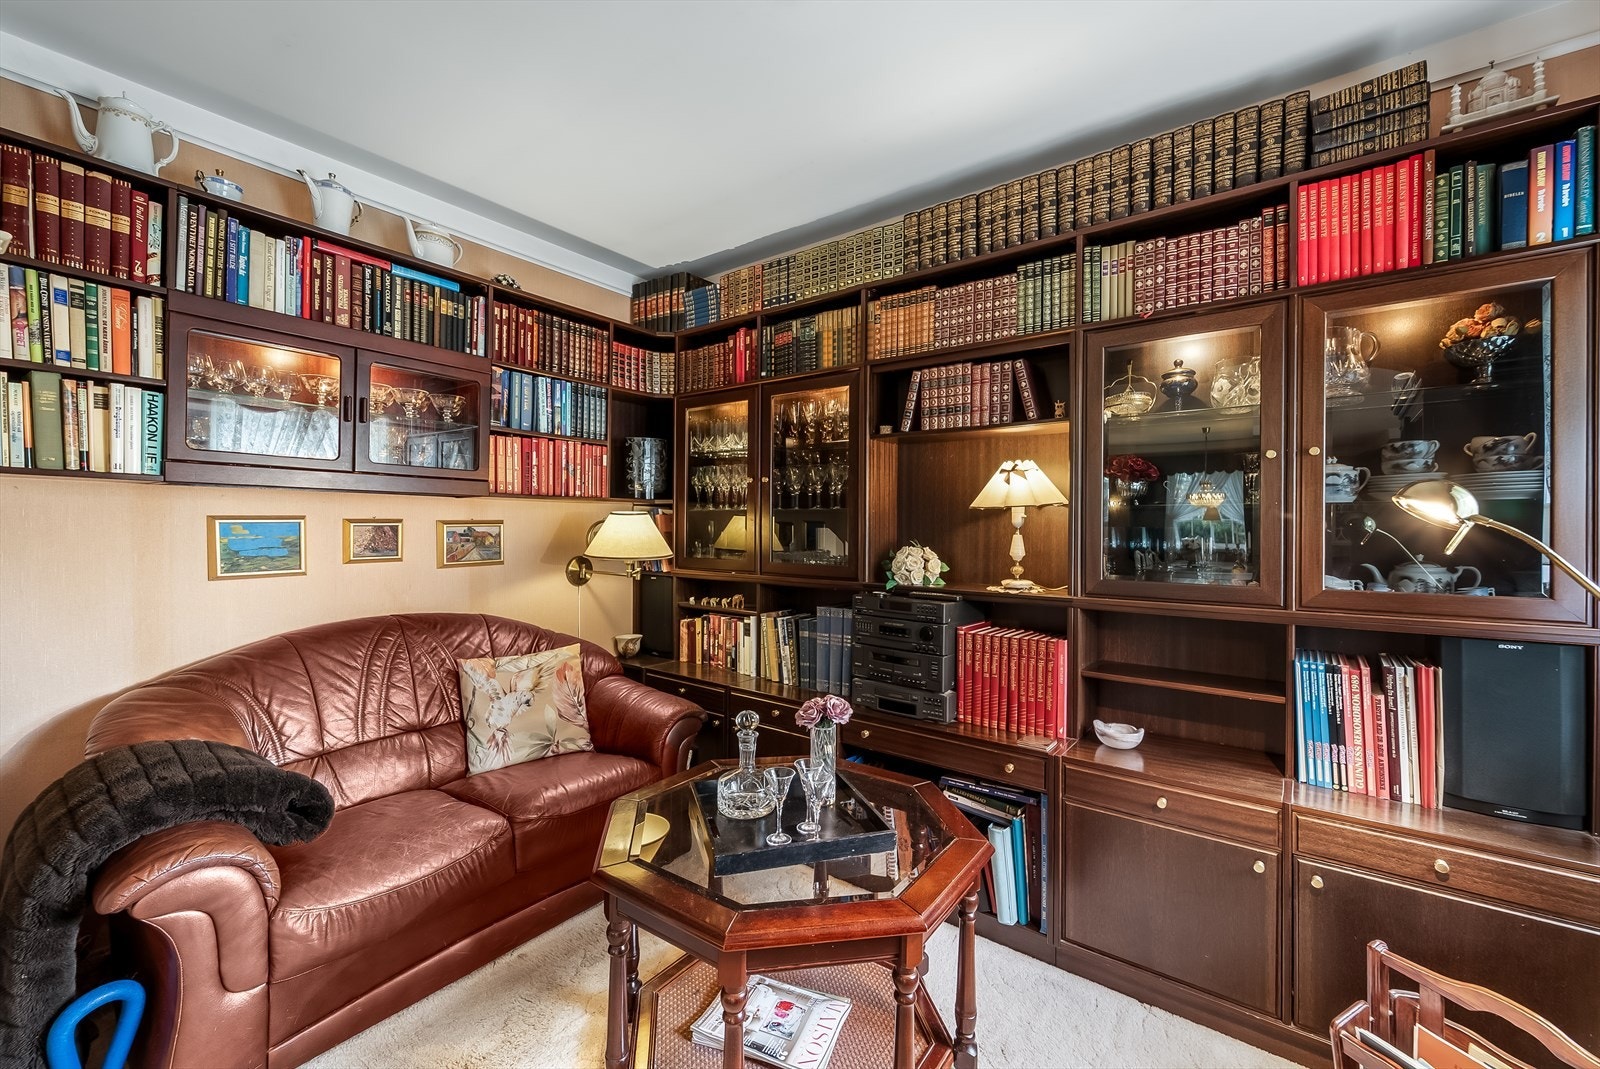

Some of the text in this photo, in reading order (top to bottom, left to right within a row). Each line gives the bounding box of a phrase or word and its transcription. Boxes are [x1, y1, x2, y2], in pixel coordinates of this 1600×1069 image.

[1537, 151, 1546, 169] IRWIN
[1580, 131, 1590, 198] JOHANNA KINGSLEY
[1537, 170, 1546, 187] SHAW
[1562, 164, 1571, 181] SHAW
[1478, 171, 1486, 226] TORNEFUGLENE
[1535, 232, 1546, 243] 2
[1561, 227, 1568, 237] 1
[39, 278, 48, 289] BILL
[40, 290, 48, 307] COSBY
[145, 393, 158, 464] HAAKON LIE
[1351, 693, 1361, 745] REKORDBOK
[1375, 698, 1383, 722] PRESTEN
[1354, 745, 1365, 789] GUINNESS
[797, 1002, 846, 1066] MAISON
